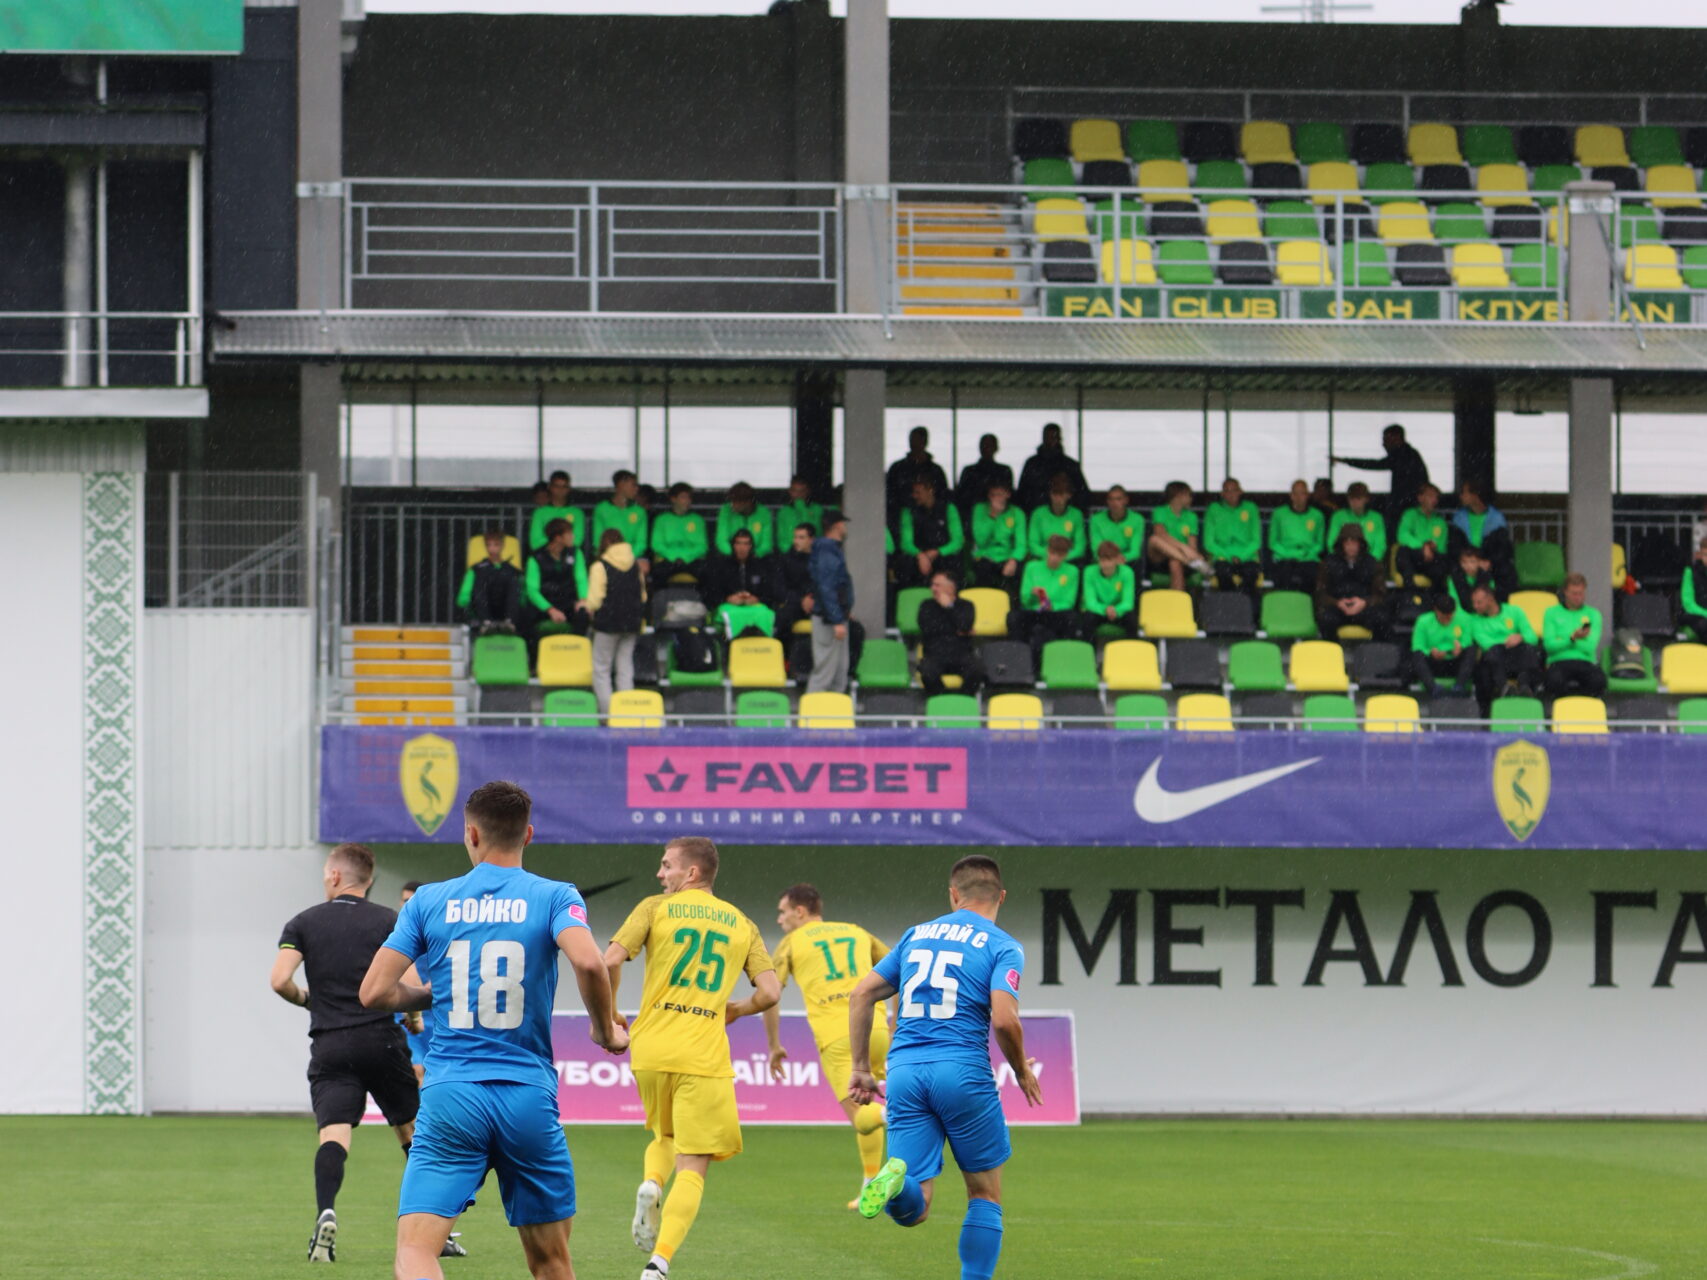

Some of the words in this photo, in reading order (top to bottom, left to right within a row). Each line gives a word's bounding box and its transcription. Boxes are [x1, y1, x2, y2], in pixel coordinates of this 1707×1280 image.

[1063, 297, 1143, 317] FAN
[1172, 297, 1278, 319] CLUB
[1609, 301, 1675, 322] AN
[705, 763, 952, 793] FAVBET
[632, 810, 805, 825] ОФІЦІЙНИЙ
[830, 812, 963, 825] ПАРТНЕР
[445, 894, 528, 924] БОЙКО
[668, 903, 737, 928] КОСОВСЬКИЙ
[1039, 886, 1553, 989] МЕТАЛО
[670, 927, 730, 993] 25
[813, 936, 858, 982] 17
[446, 940, 525, 1030] 18
[902, 948, 964, 1020] 25
[664, 1002, 718, 1020] FAVBET
